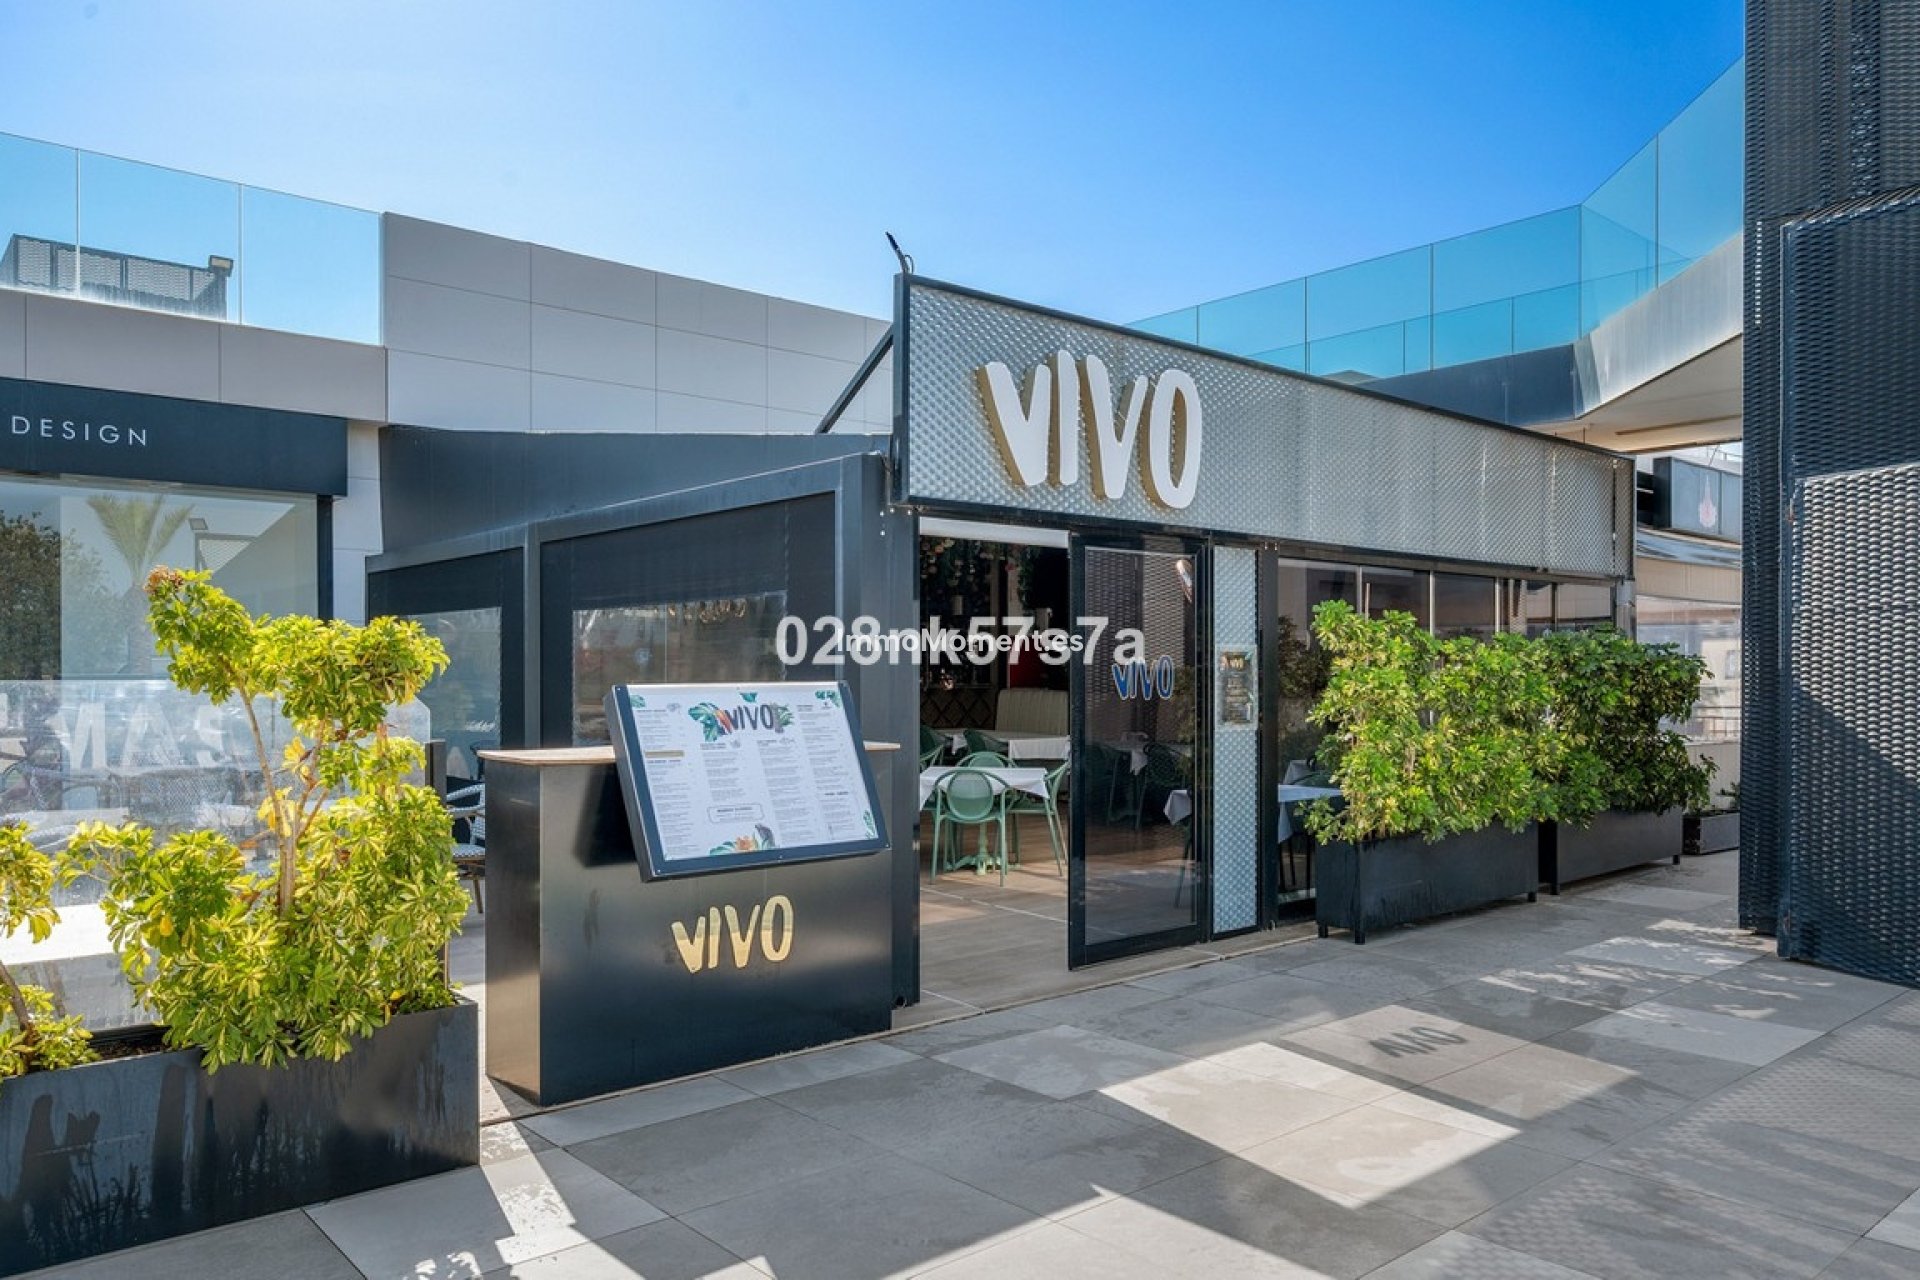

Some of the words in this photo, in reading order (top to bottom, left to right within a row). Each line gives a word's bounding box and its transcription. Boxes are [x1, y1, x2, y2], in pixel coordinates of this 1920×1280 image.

[11, 415, 147, 446] DESIGN
[985, 350, 1203, 509] VIVO
[1112, 655, 1174, 701] VIVO
[724, 704, 775, 731] VIVO
[671, 894, 794, 974] VIVO
